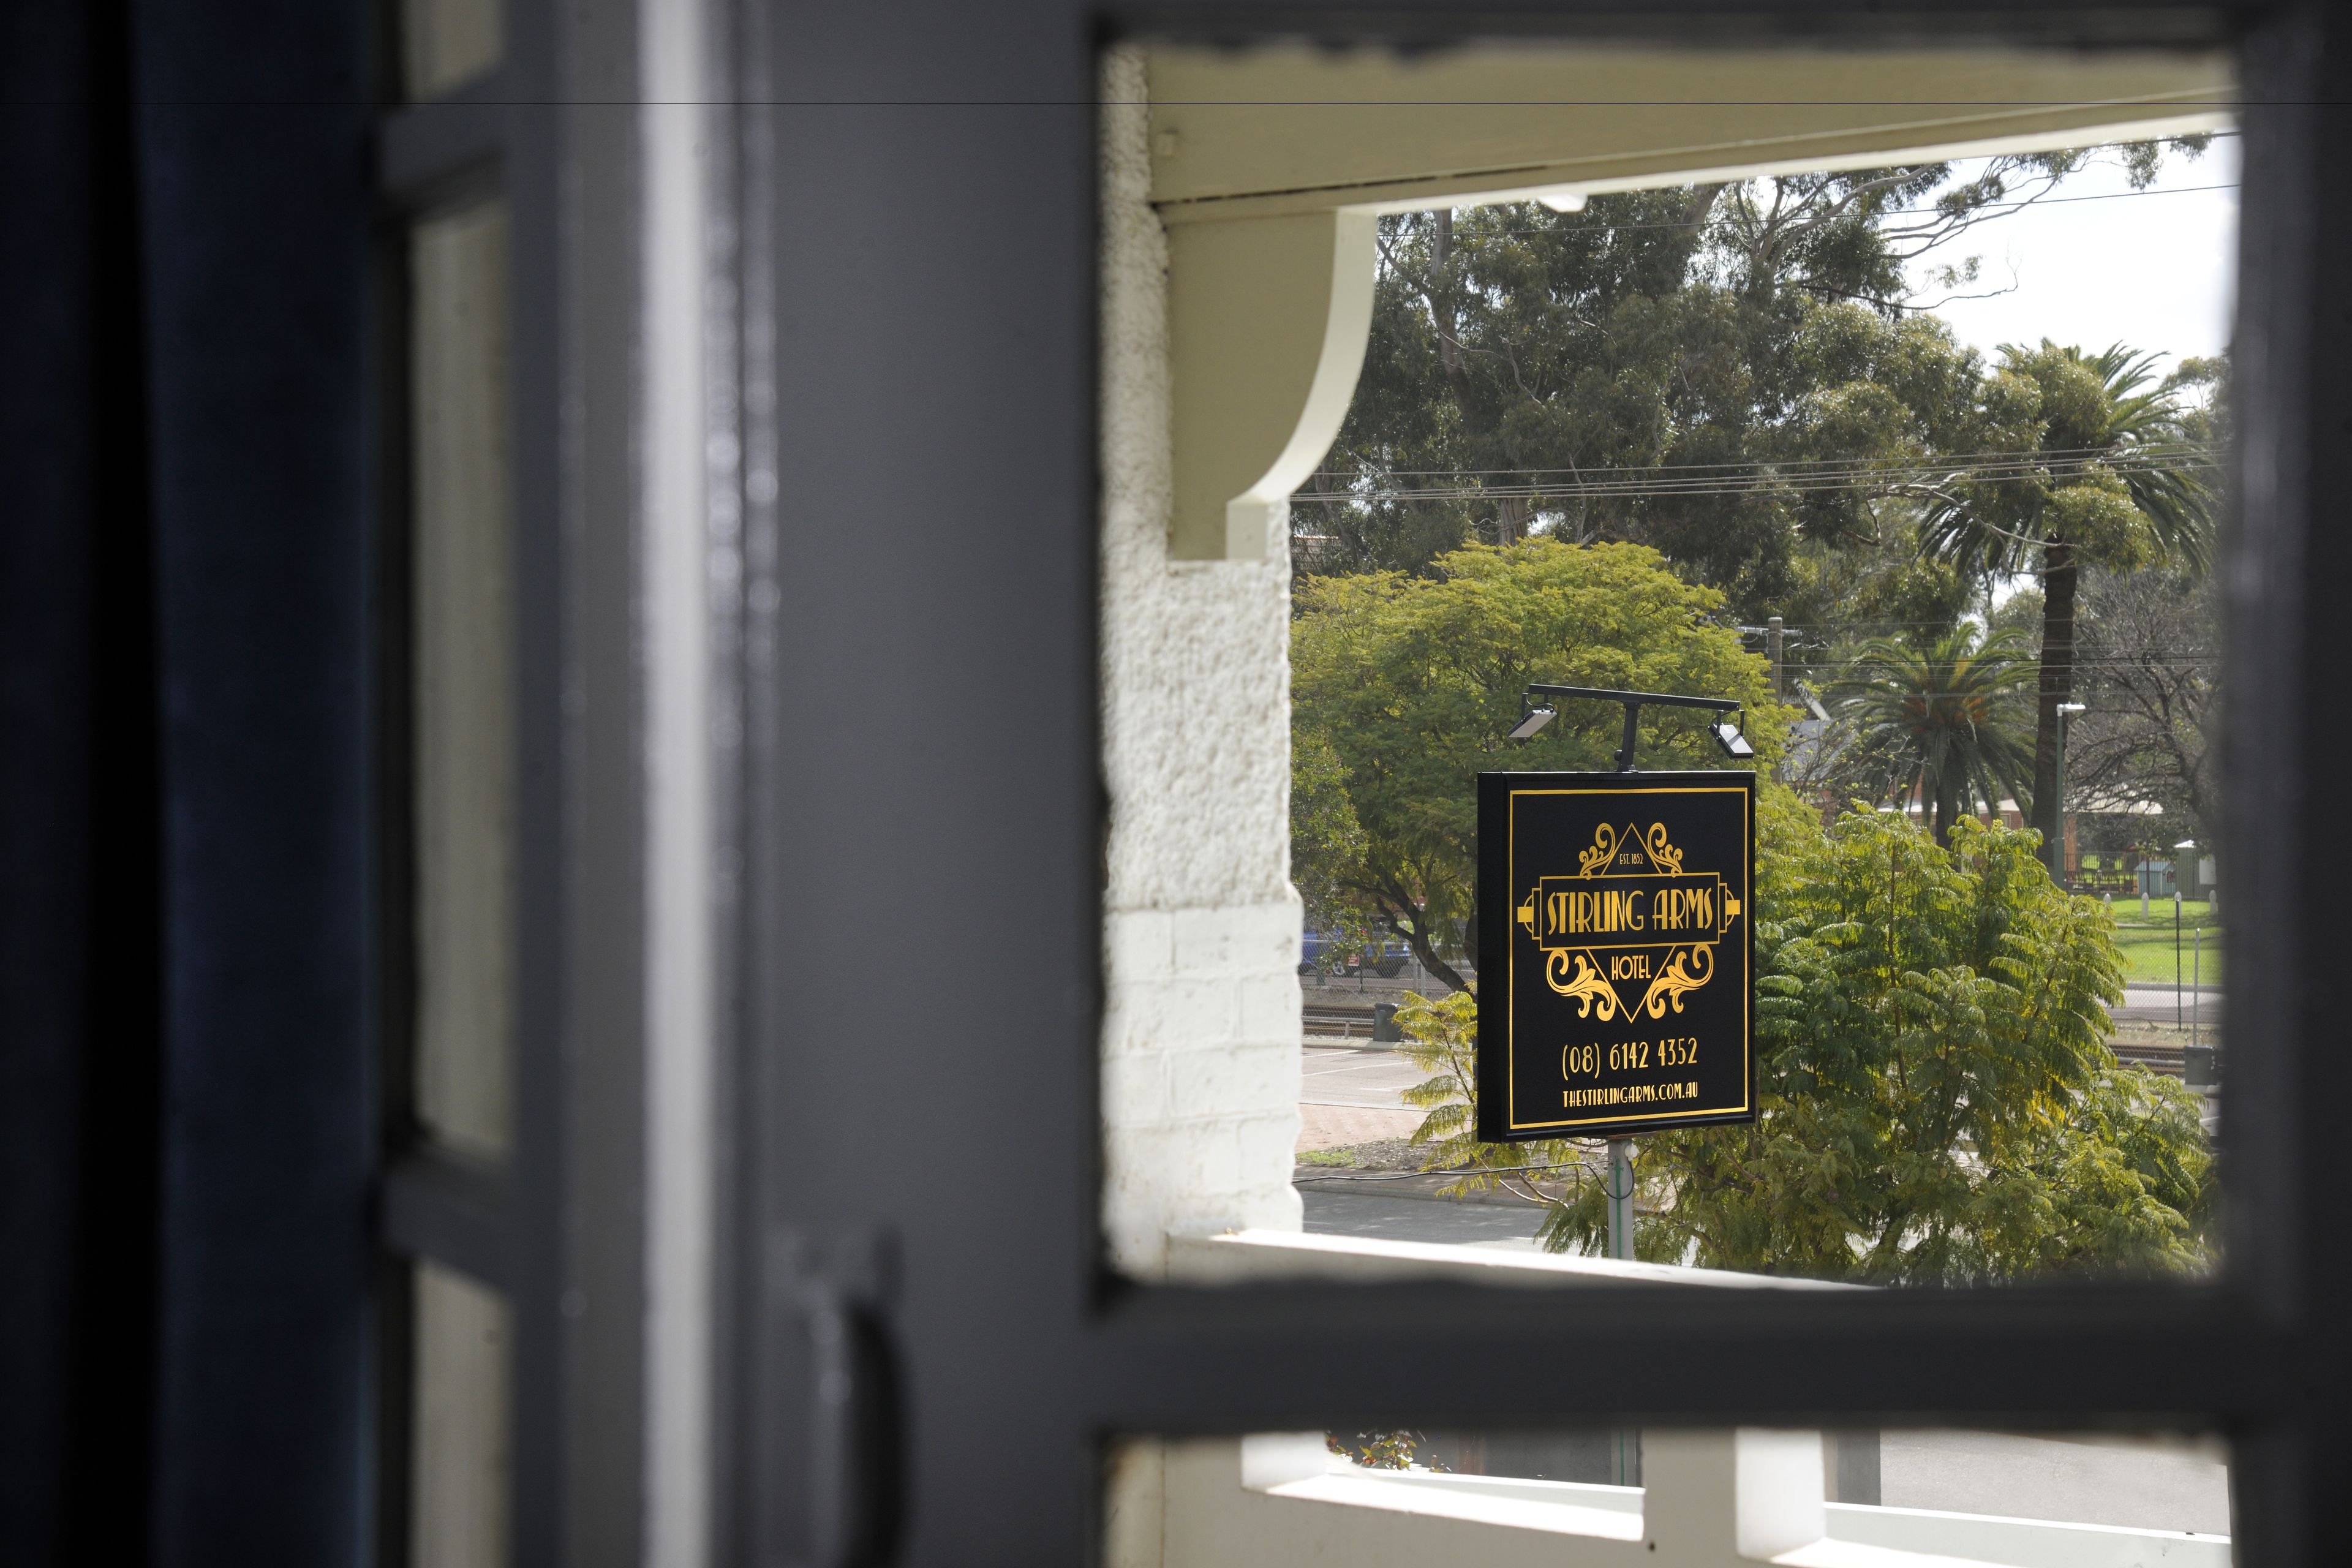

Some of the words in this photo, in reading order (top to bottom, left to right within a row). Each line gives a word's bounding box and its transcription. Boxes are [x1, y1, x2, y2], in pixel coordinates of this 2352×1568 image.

[1619, 853, 1630, 864] EST.
[1631, 853, 1643, 864] 1852
[1547, 890, 1644, 935] STIRLING
[1652, 888, 1713, 930] ARMS
[1611, 955, 1651, 981] HOTEL
[1562, 1042, 1600, 1081] (08)
[1609, 1041, 1649, 1071] 6142
[1657, 1037, 1697, 1066] 4352
[1562, 1081, 1698, 1108] THESTIRLINGARMS.COM.AU
